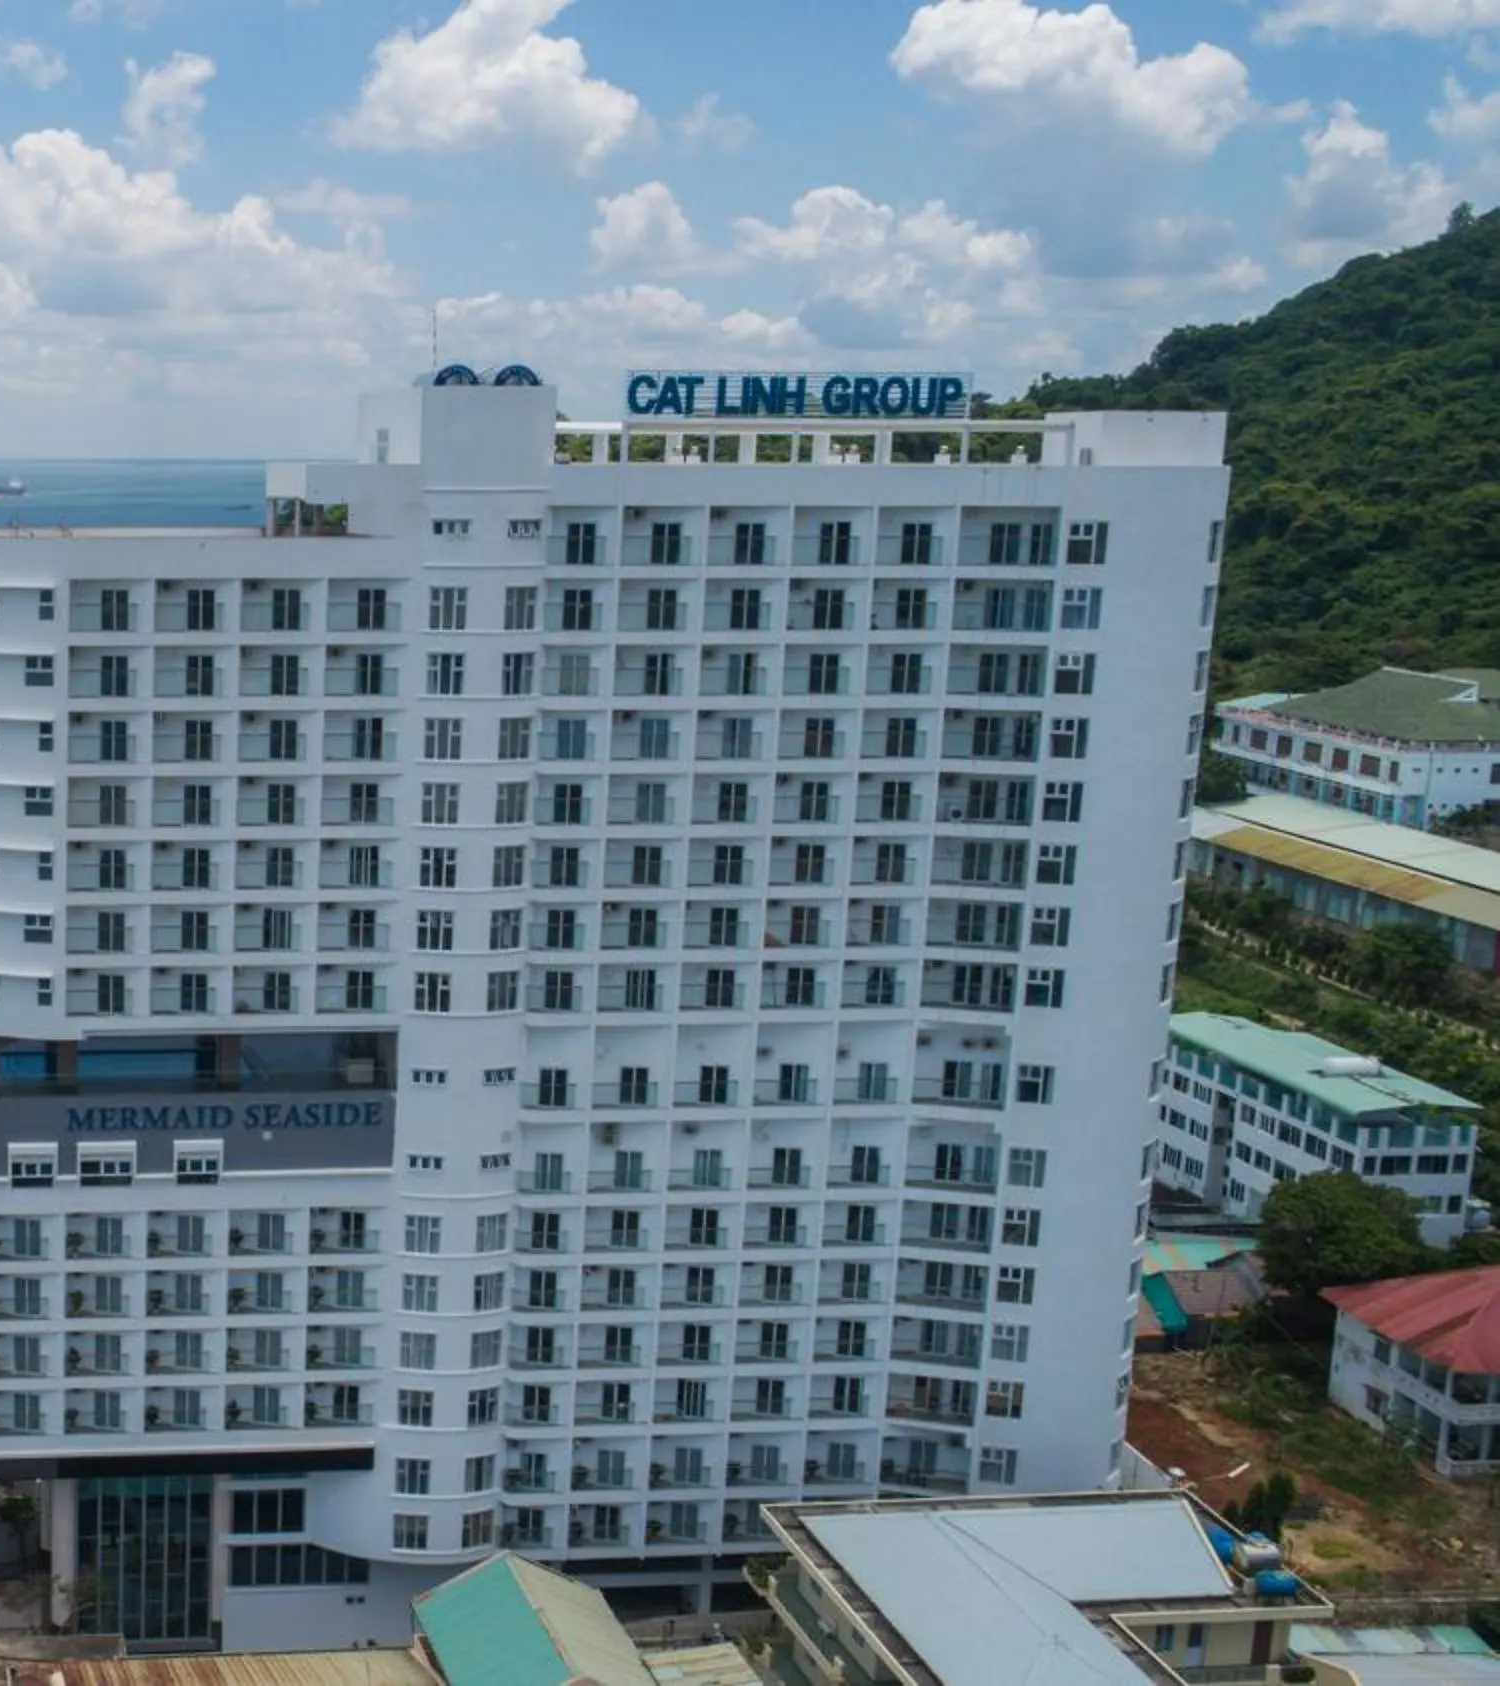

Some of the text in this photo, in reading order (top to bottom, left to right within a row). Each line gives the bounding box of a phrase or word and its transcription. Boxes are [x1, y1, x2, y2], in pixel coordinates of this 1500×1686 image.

[627, 375, 964, 417] CAT LINH GROUP
[67, 1101, 384, 1132] MERMAID SEASIDE
